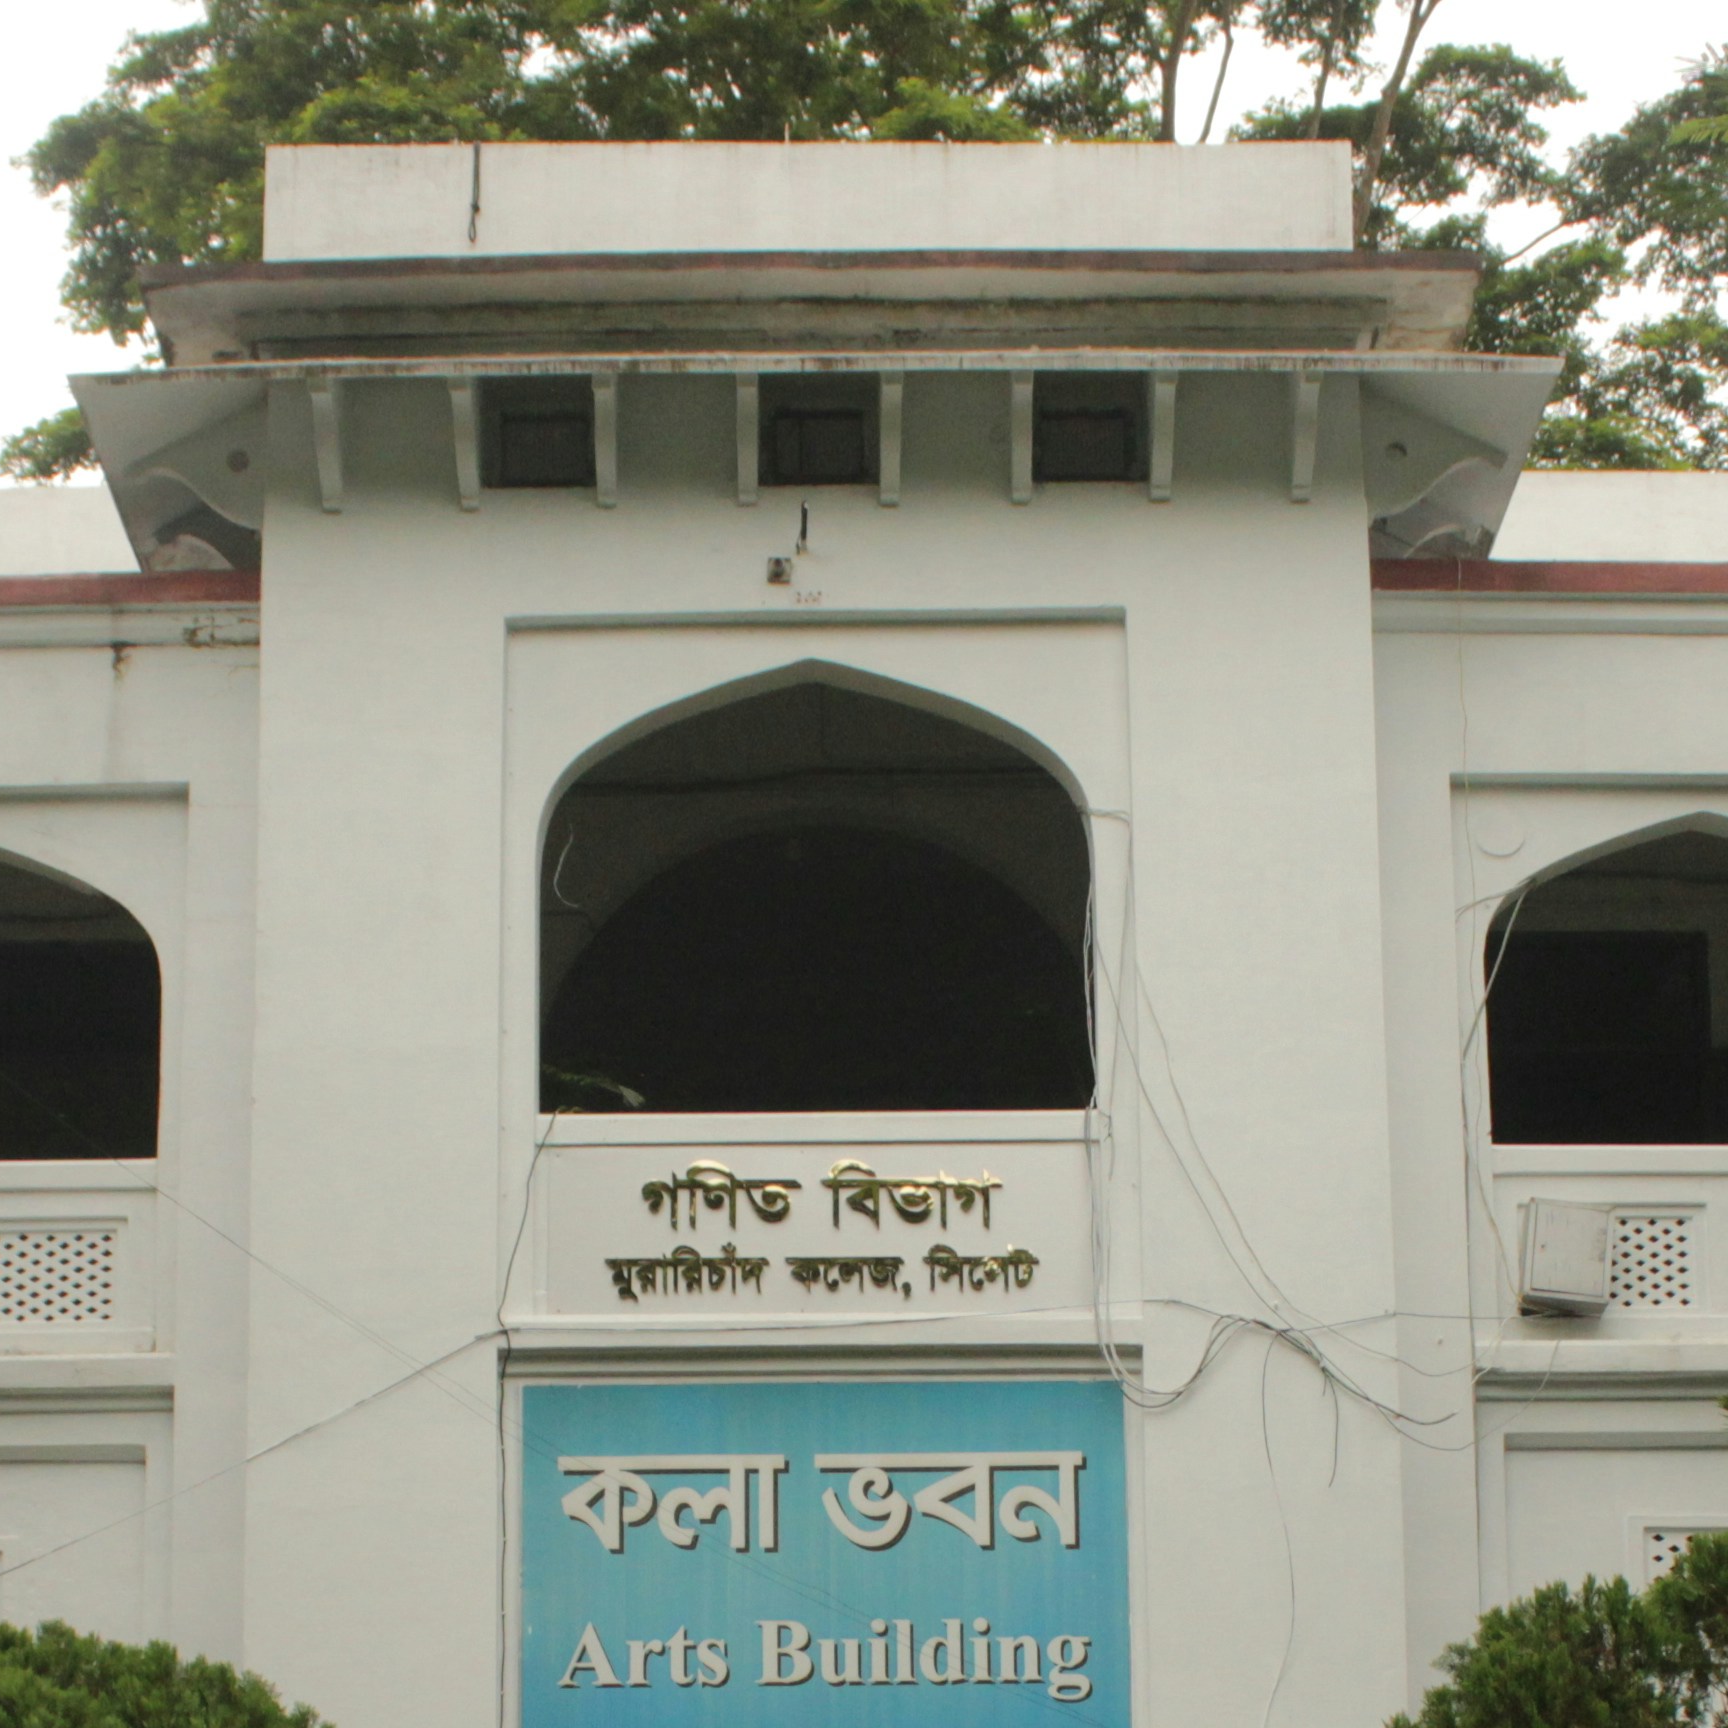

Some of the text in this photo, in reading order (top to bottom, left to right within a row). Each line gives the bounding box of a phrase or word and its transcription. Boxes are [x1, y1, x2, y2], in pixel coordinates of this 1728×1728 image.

[641, 1158, 1003, 1231] গণিত বিভাগ
[604, 1242, 1039, 1303] মুরারিচাঁদ কলেজ, সিলেট
[558, 1451, 1086, 1553] কলা ভবন
[557, 1617, 1092, 1702] Arts Building
